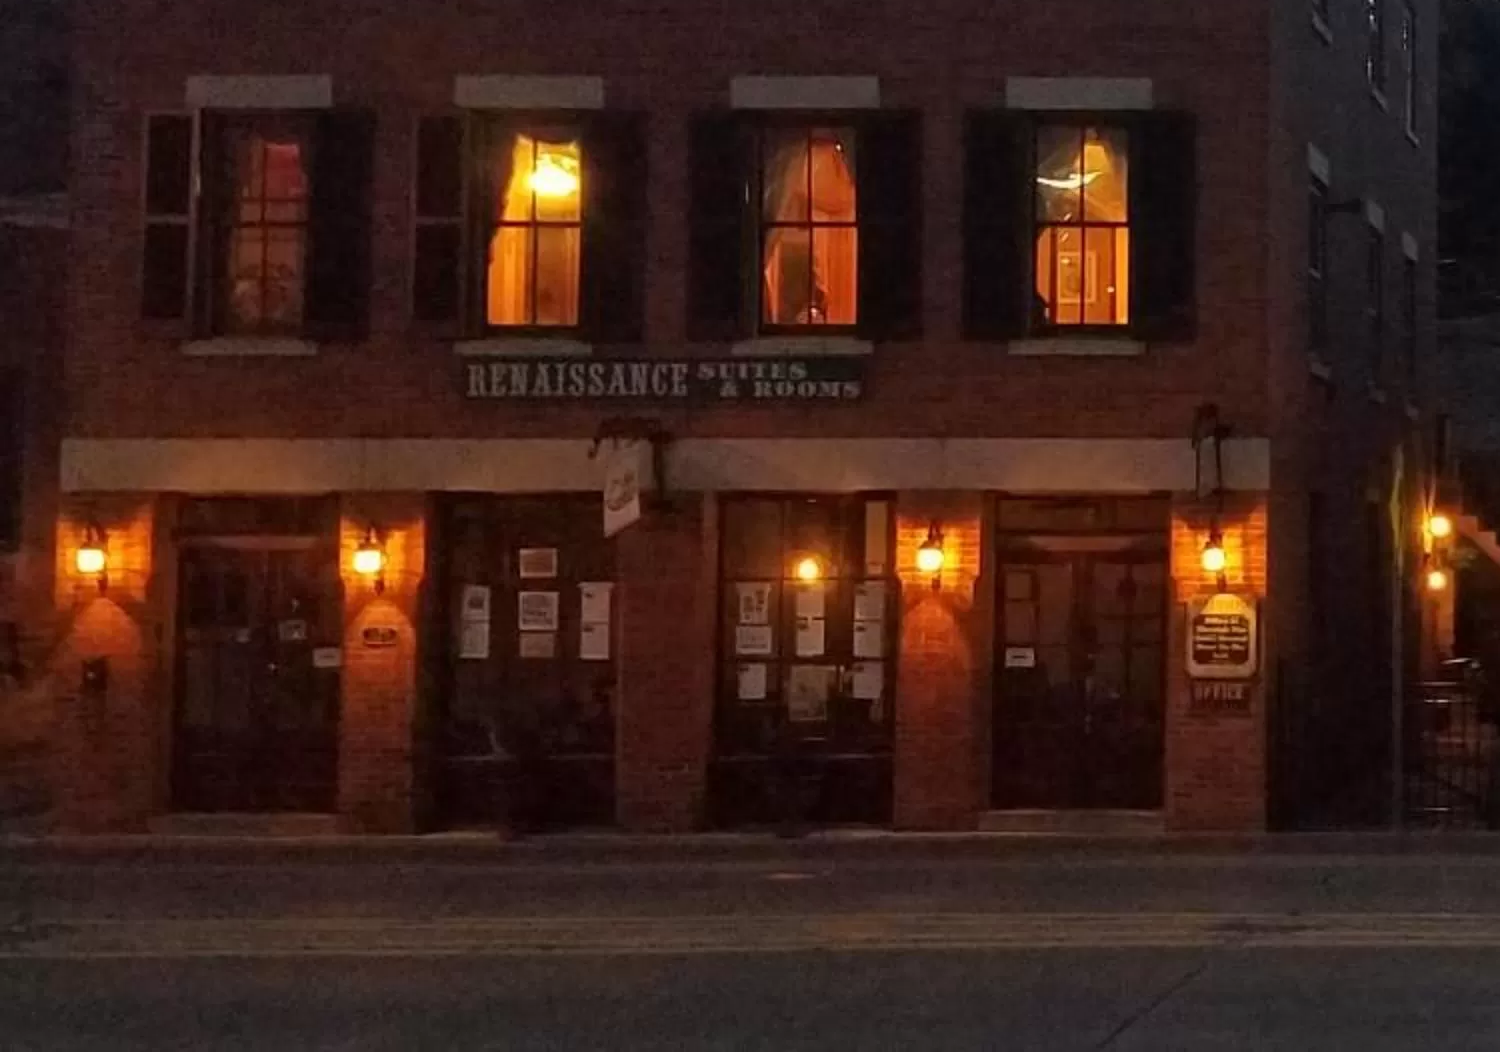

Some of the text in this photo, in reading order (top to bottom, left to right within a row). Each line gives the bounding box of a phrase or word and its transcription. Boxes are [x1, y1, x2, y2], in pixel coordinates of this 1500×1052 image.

[466, 360, 808, 398] RENAISSANCE SUITES
[718, 380, 862, 399] & ROOMS
